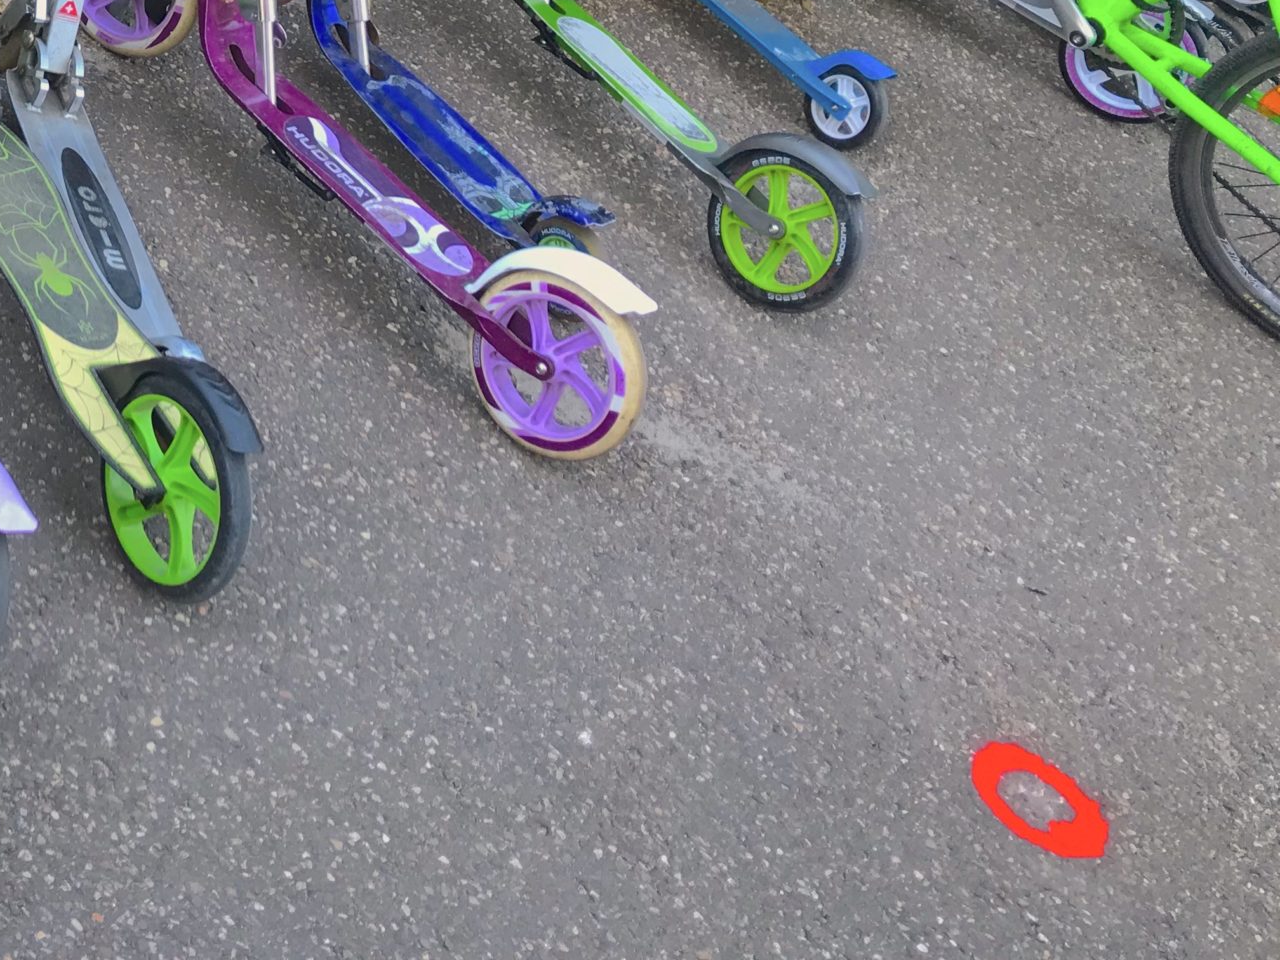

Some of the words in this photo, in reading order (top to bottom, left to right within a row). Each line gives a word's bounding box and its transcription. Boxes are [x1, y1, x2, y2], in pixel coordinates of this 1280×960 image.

[286, 125, 367, 198] HUDORA
[713, 200, 724, 236] HUDOR
[834, 221, 848, 263] HUDORA
